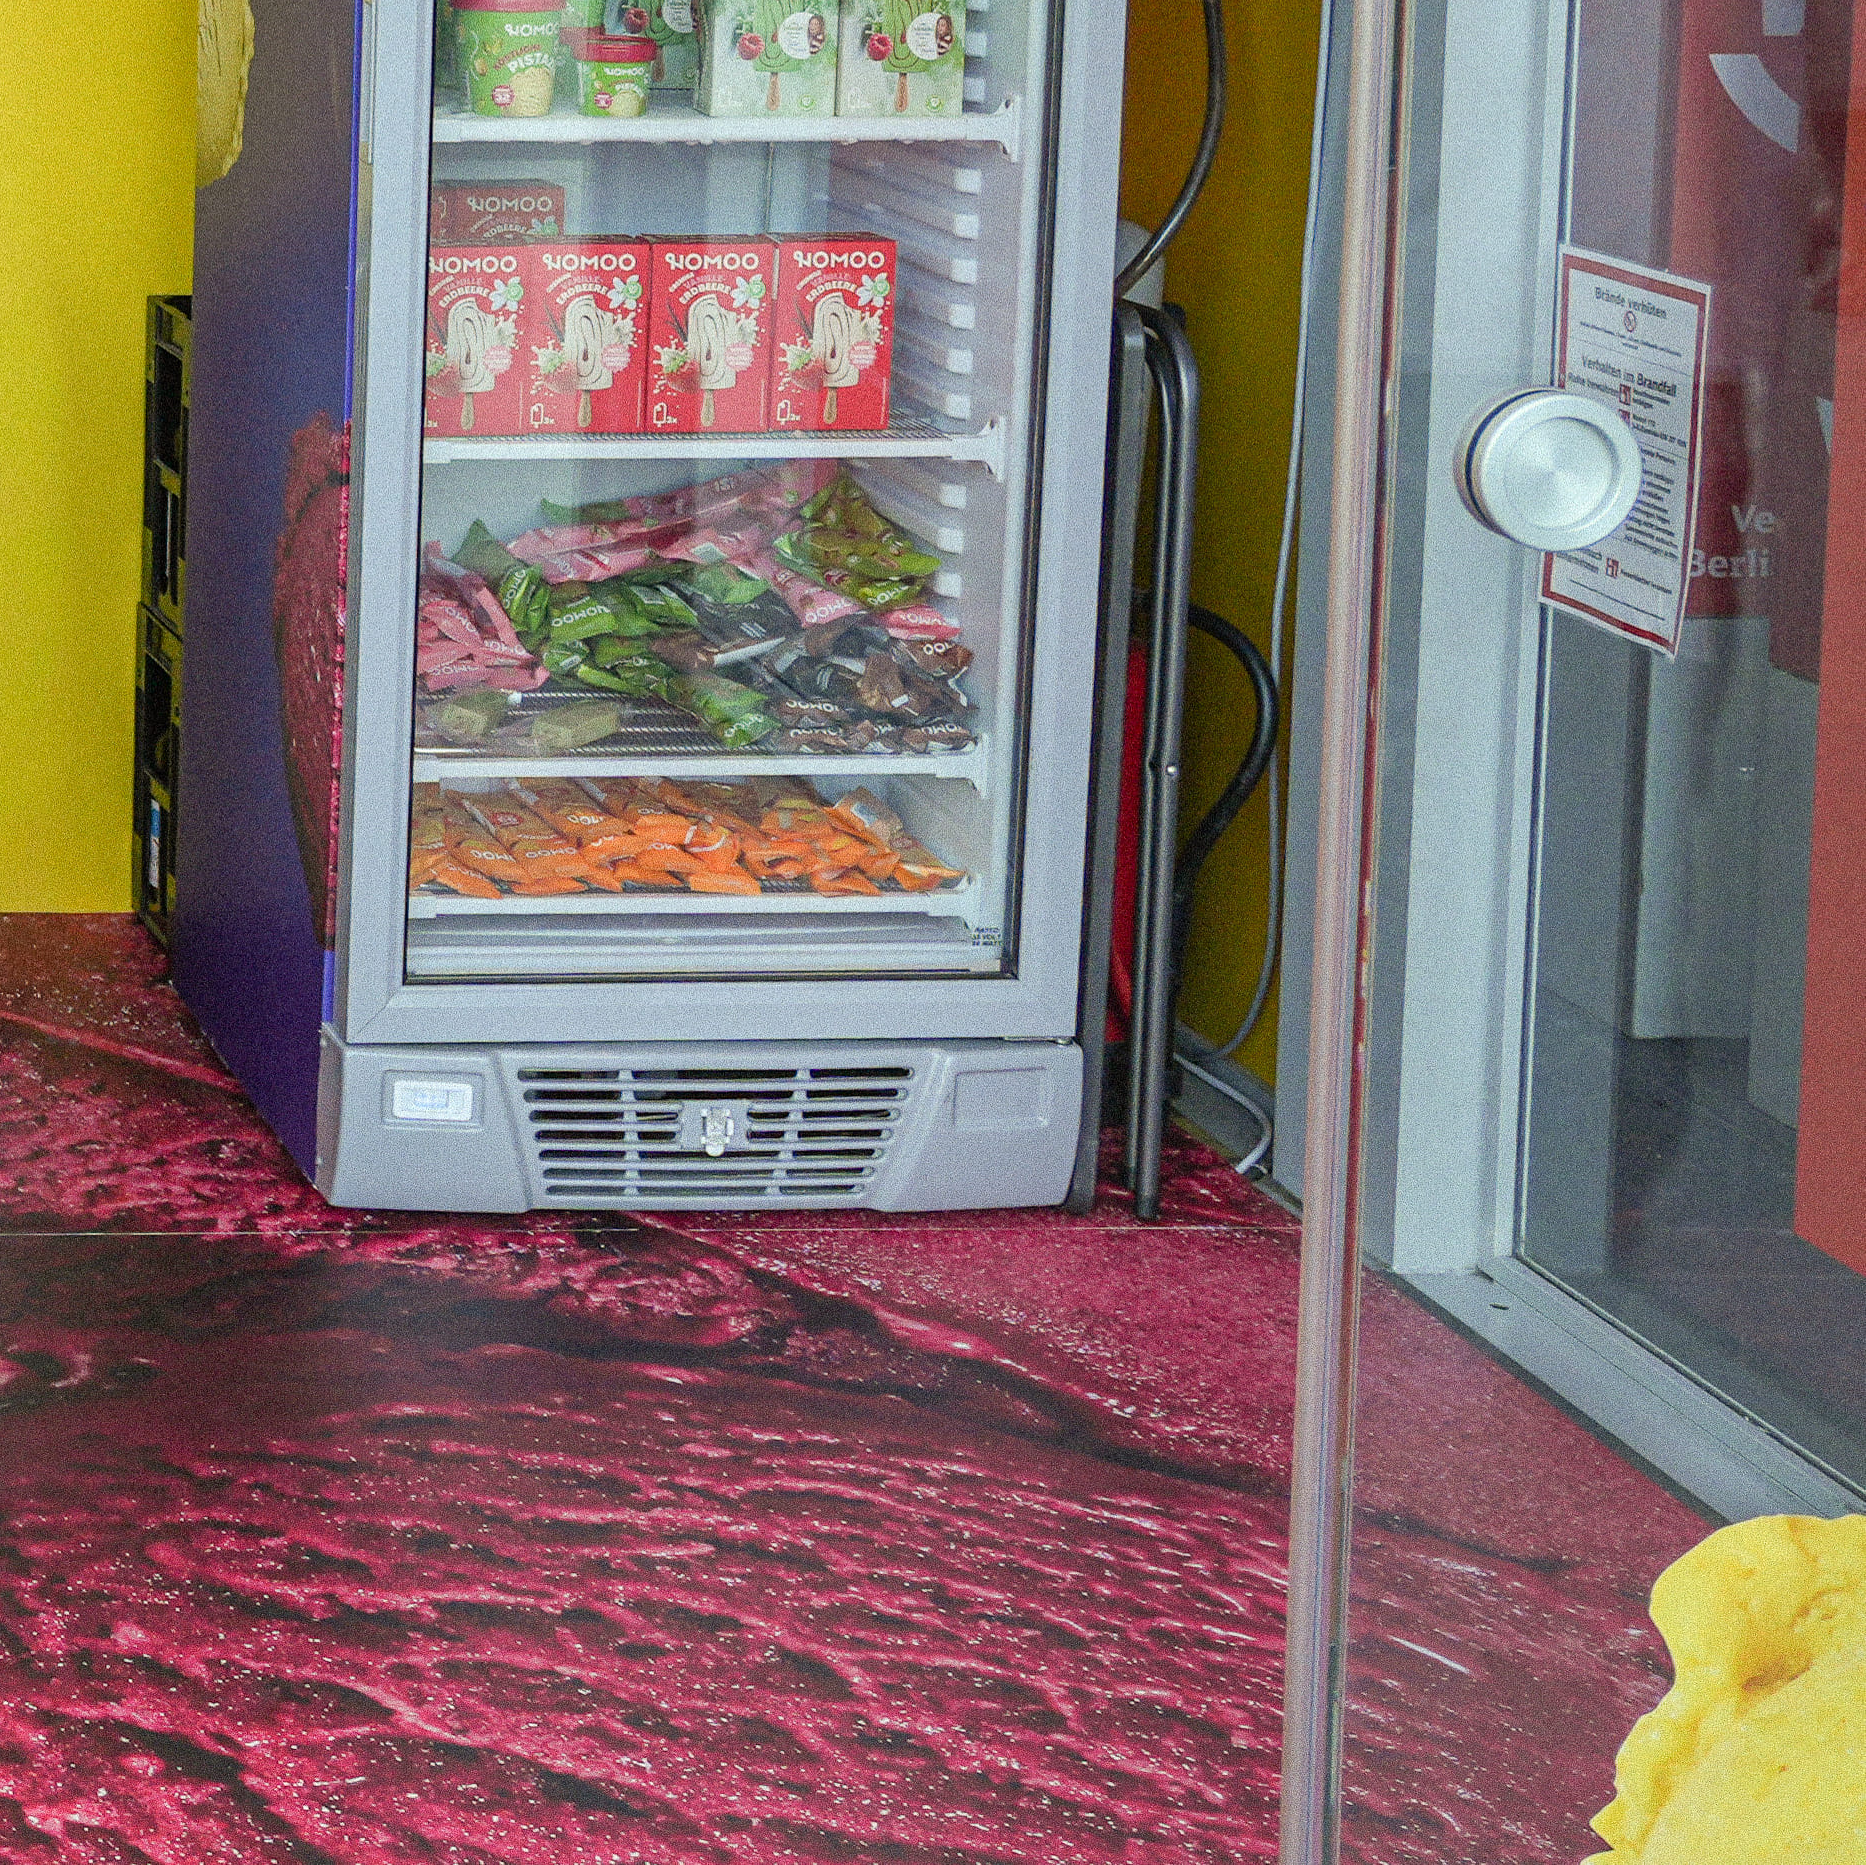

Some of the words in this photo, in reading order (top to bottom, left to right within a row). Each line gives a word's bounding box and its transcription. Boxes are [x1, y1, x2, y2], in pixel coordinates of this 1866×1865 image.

[467, 196, 553, 213] NOMOO
[542, 253, 637, 271] NOMOO
[665, 252, 759, 270] NOMOO
[793, 250, 885, 269] NOMOO
[1636, 372, 1678, 398] Brandfall
